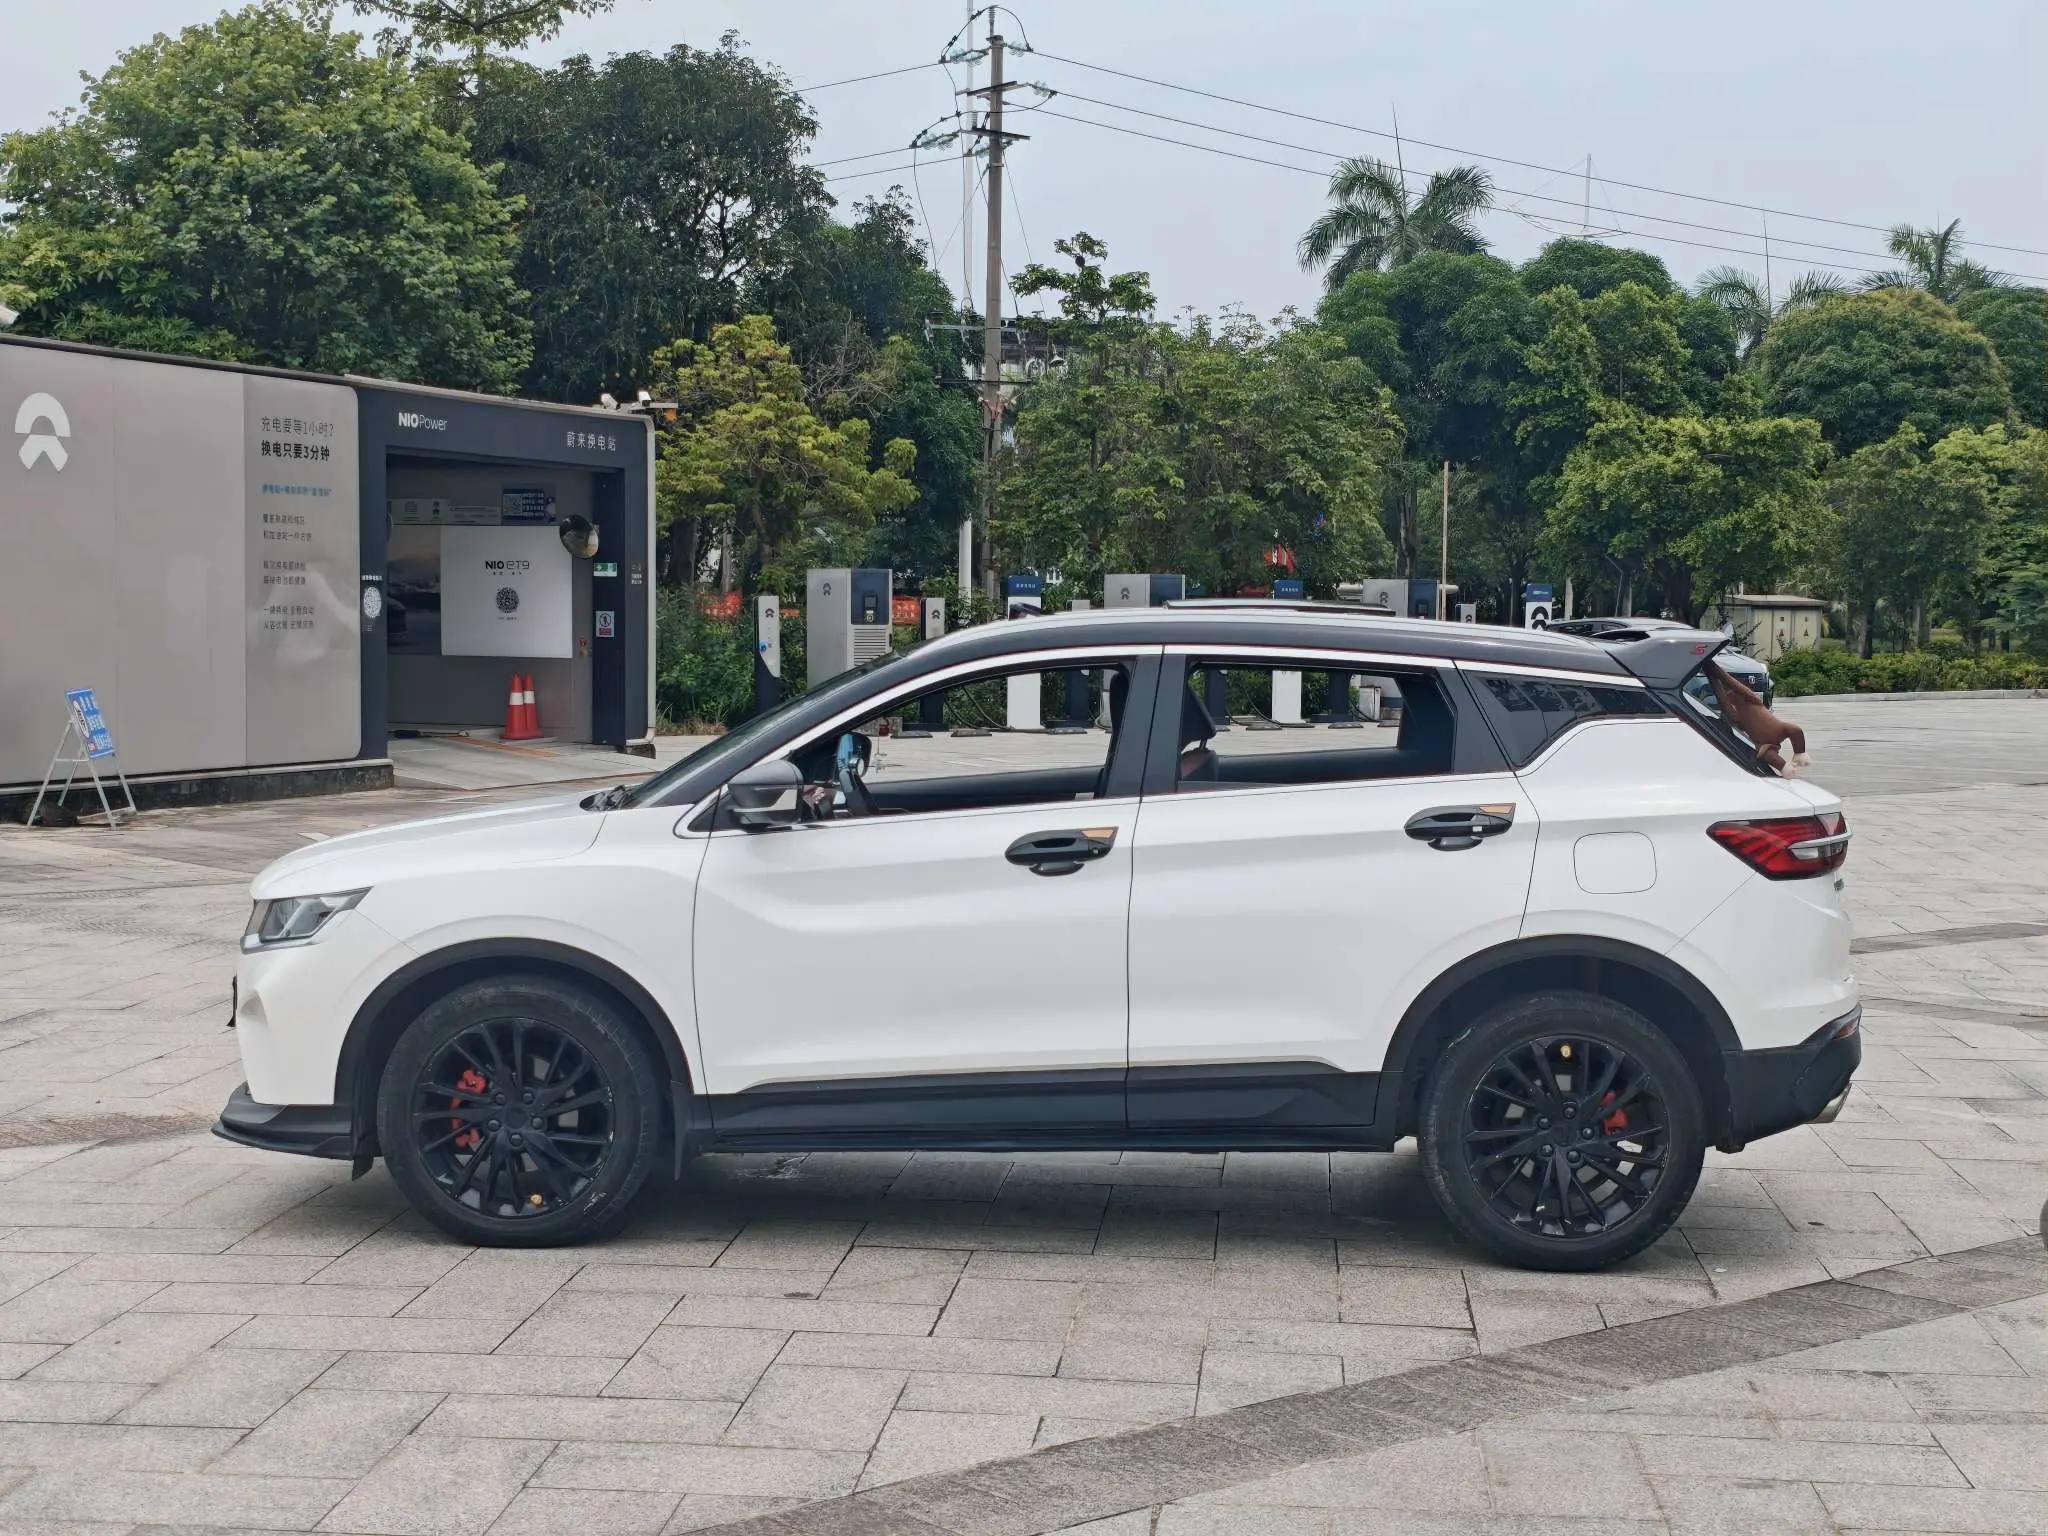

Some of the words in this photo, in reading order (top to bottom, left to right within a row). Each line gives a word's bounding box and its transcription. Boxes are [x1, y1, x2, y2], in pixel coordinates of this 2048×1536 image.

[398, 412, 448, 432] NIOPower
[261, 439, 331, 462] 换电只要3分钟
[566, 431, 617, 452] 蔚来换电站
[485, 560, 505, 570] NIO
